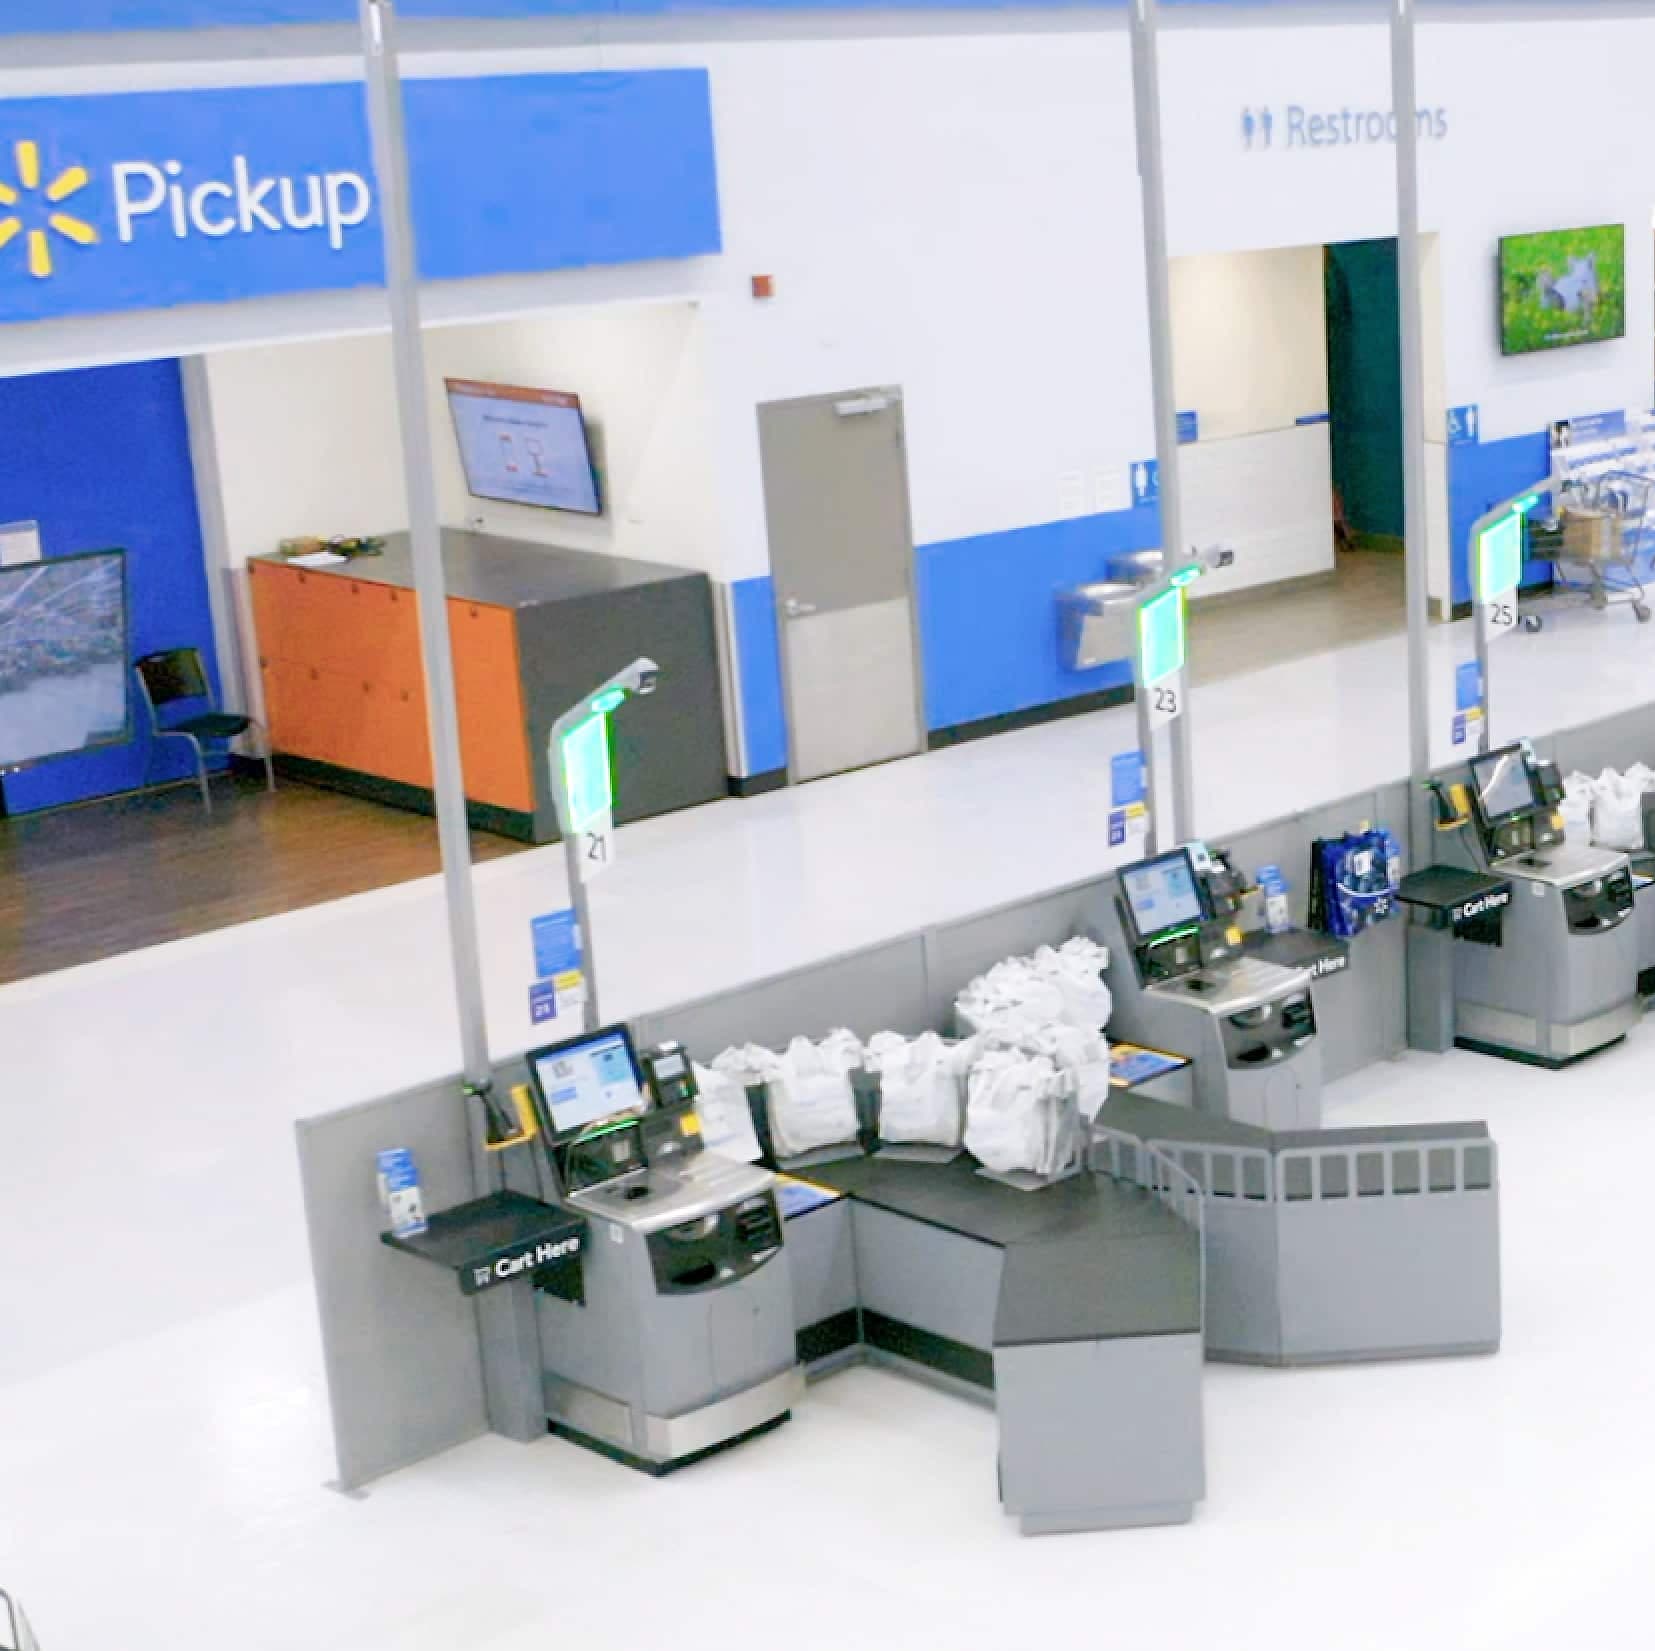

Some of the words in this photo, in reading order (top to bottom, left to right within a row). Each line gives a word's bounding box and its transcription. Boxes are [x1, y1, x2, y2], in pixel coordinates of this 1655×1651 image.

[113, 156, 372, 250] Pickup
[1488, 603, 1513, 625] 25
[1152, 687, 1177, 713] 23
[586, 832, 607, 862] 21
[495, 1250, 535, 1278] Cart
[536, 1238, 580, 1264] Here
